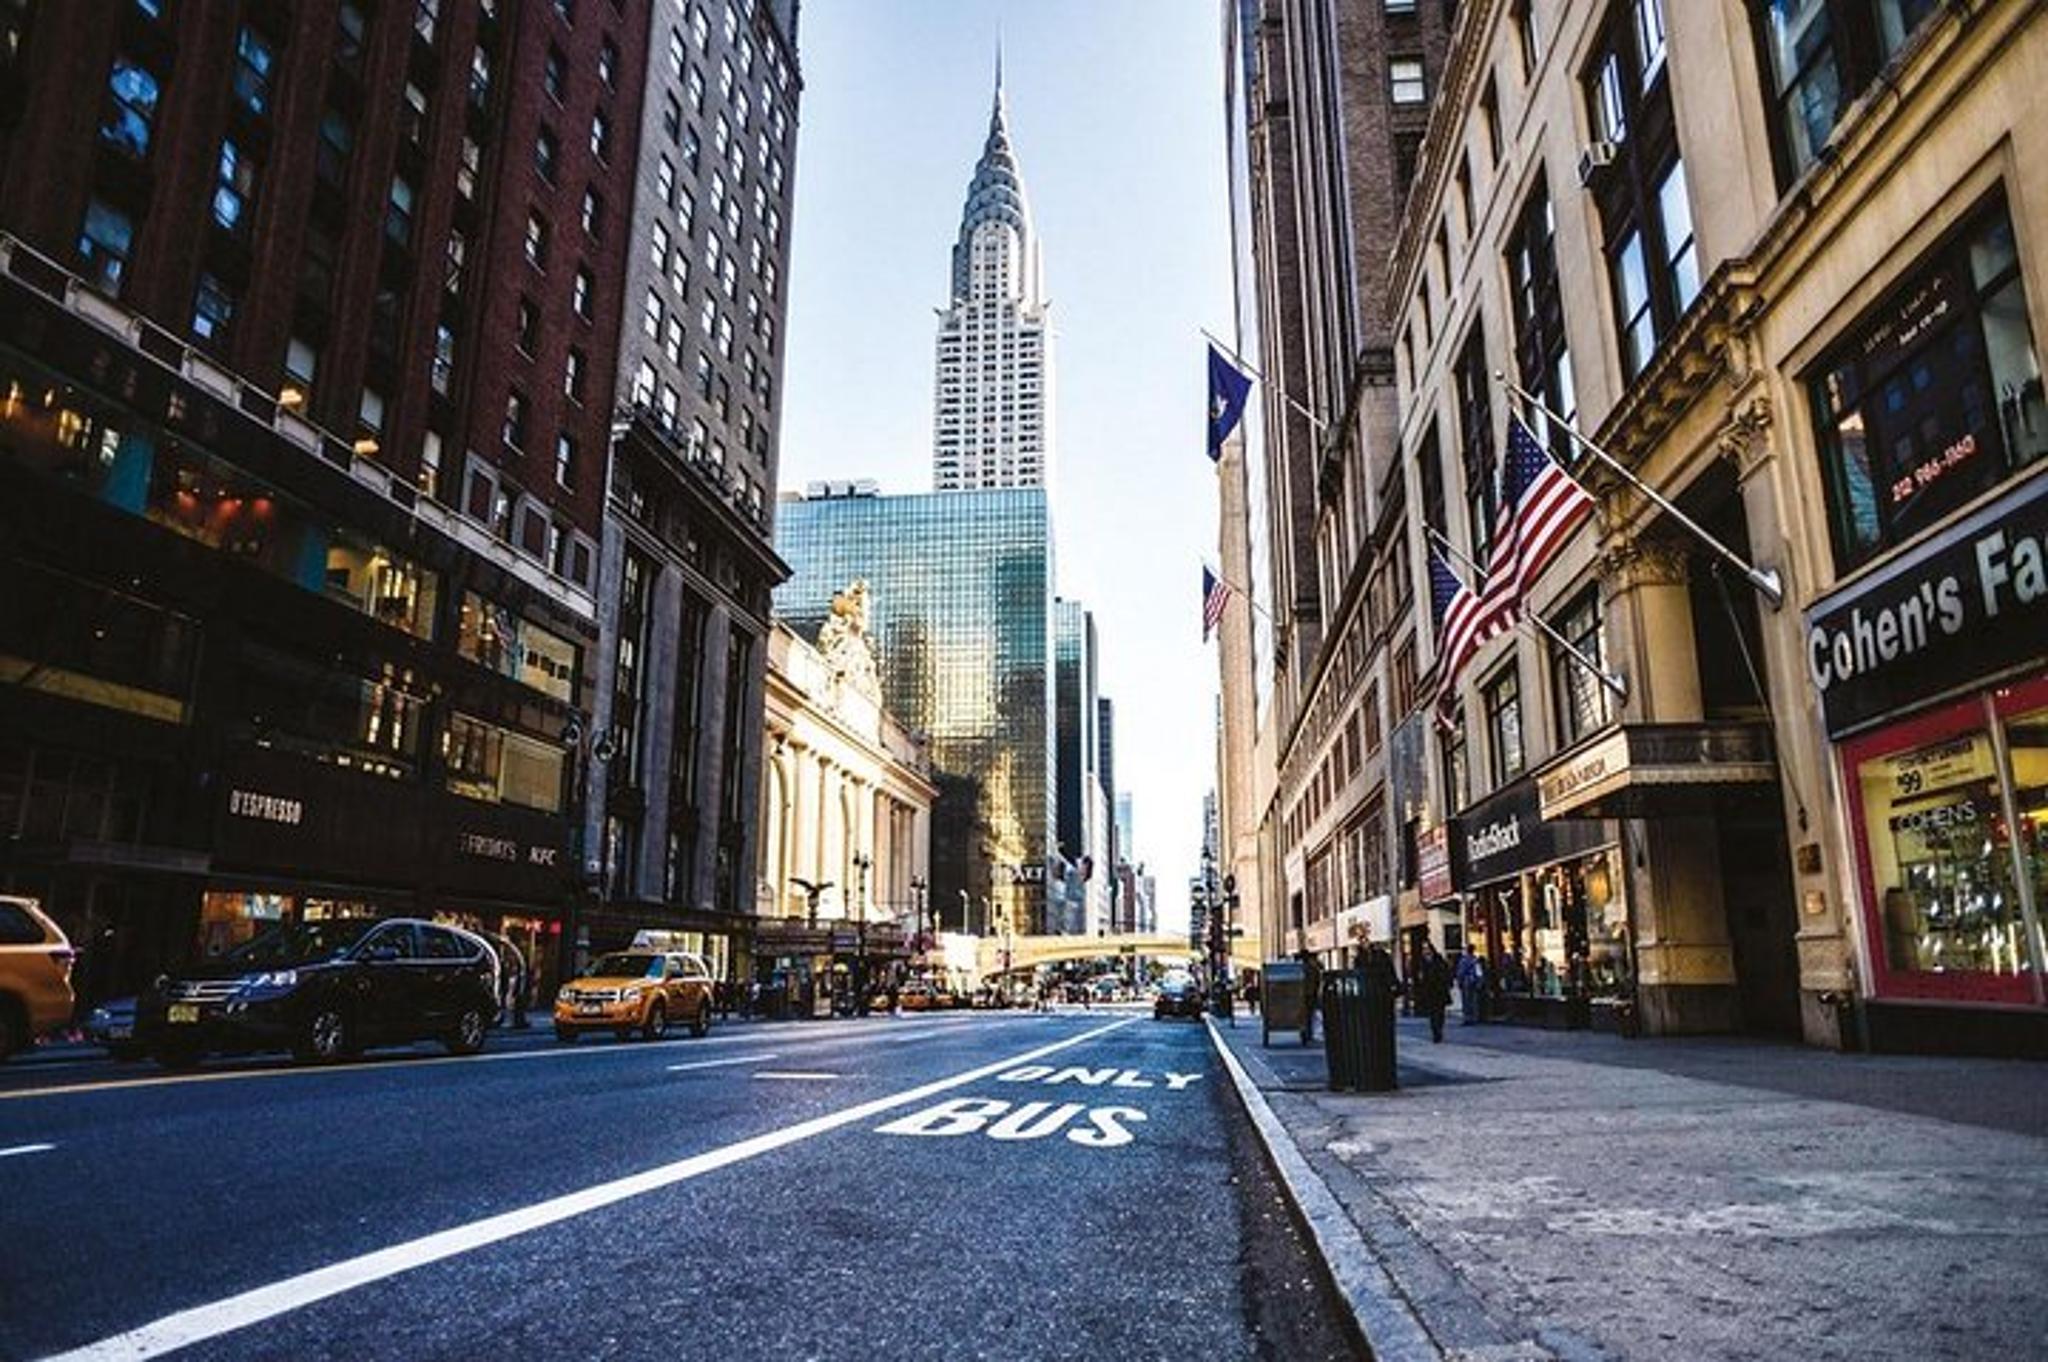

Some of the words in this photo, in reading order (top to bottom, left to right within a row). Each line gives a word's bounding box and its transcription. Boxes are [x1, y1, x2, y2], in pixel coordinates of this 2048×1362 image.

[1808, 575, 1964, 690] Cohen's
[1975, 529, 2048, 617] Fa
[997, 1065, 1203, 1090] ONLY
[873, 1097, 1148, 1147] BUS
